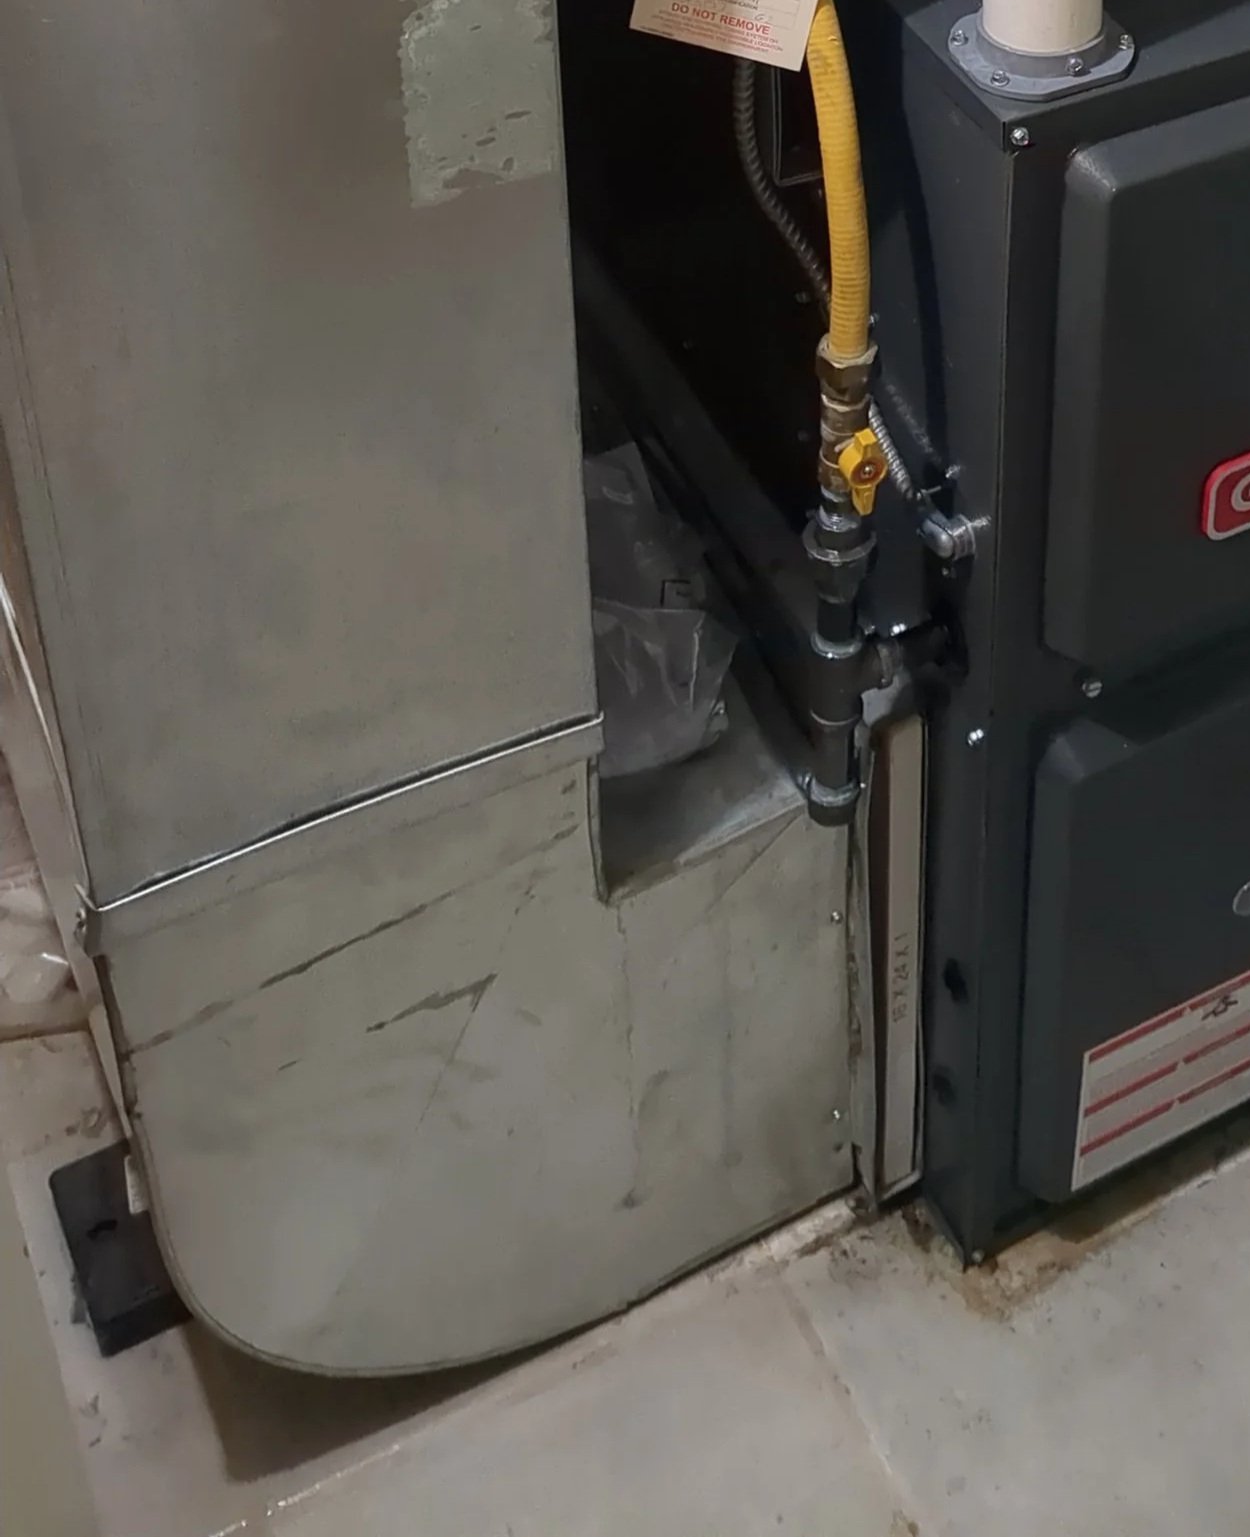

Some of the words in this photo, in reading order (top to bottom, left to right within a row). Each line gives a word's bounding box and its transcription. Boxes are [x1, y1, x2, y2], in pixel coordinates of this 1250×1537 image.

[671, 2, 690, 15] DO
[692, 7, 717, 21] NOT
[719, 14, 771, 36] REMOVE
